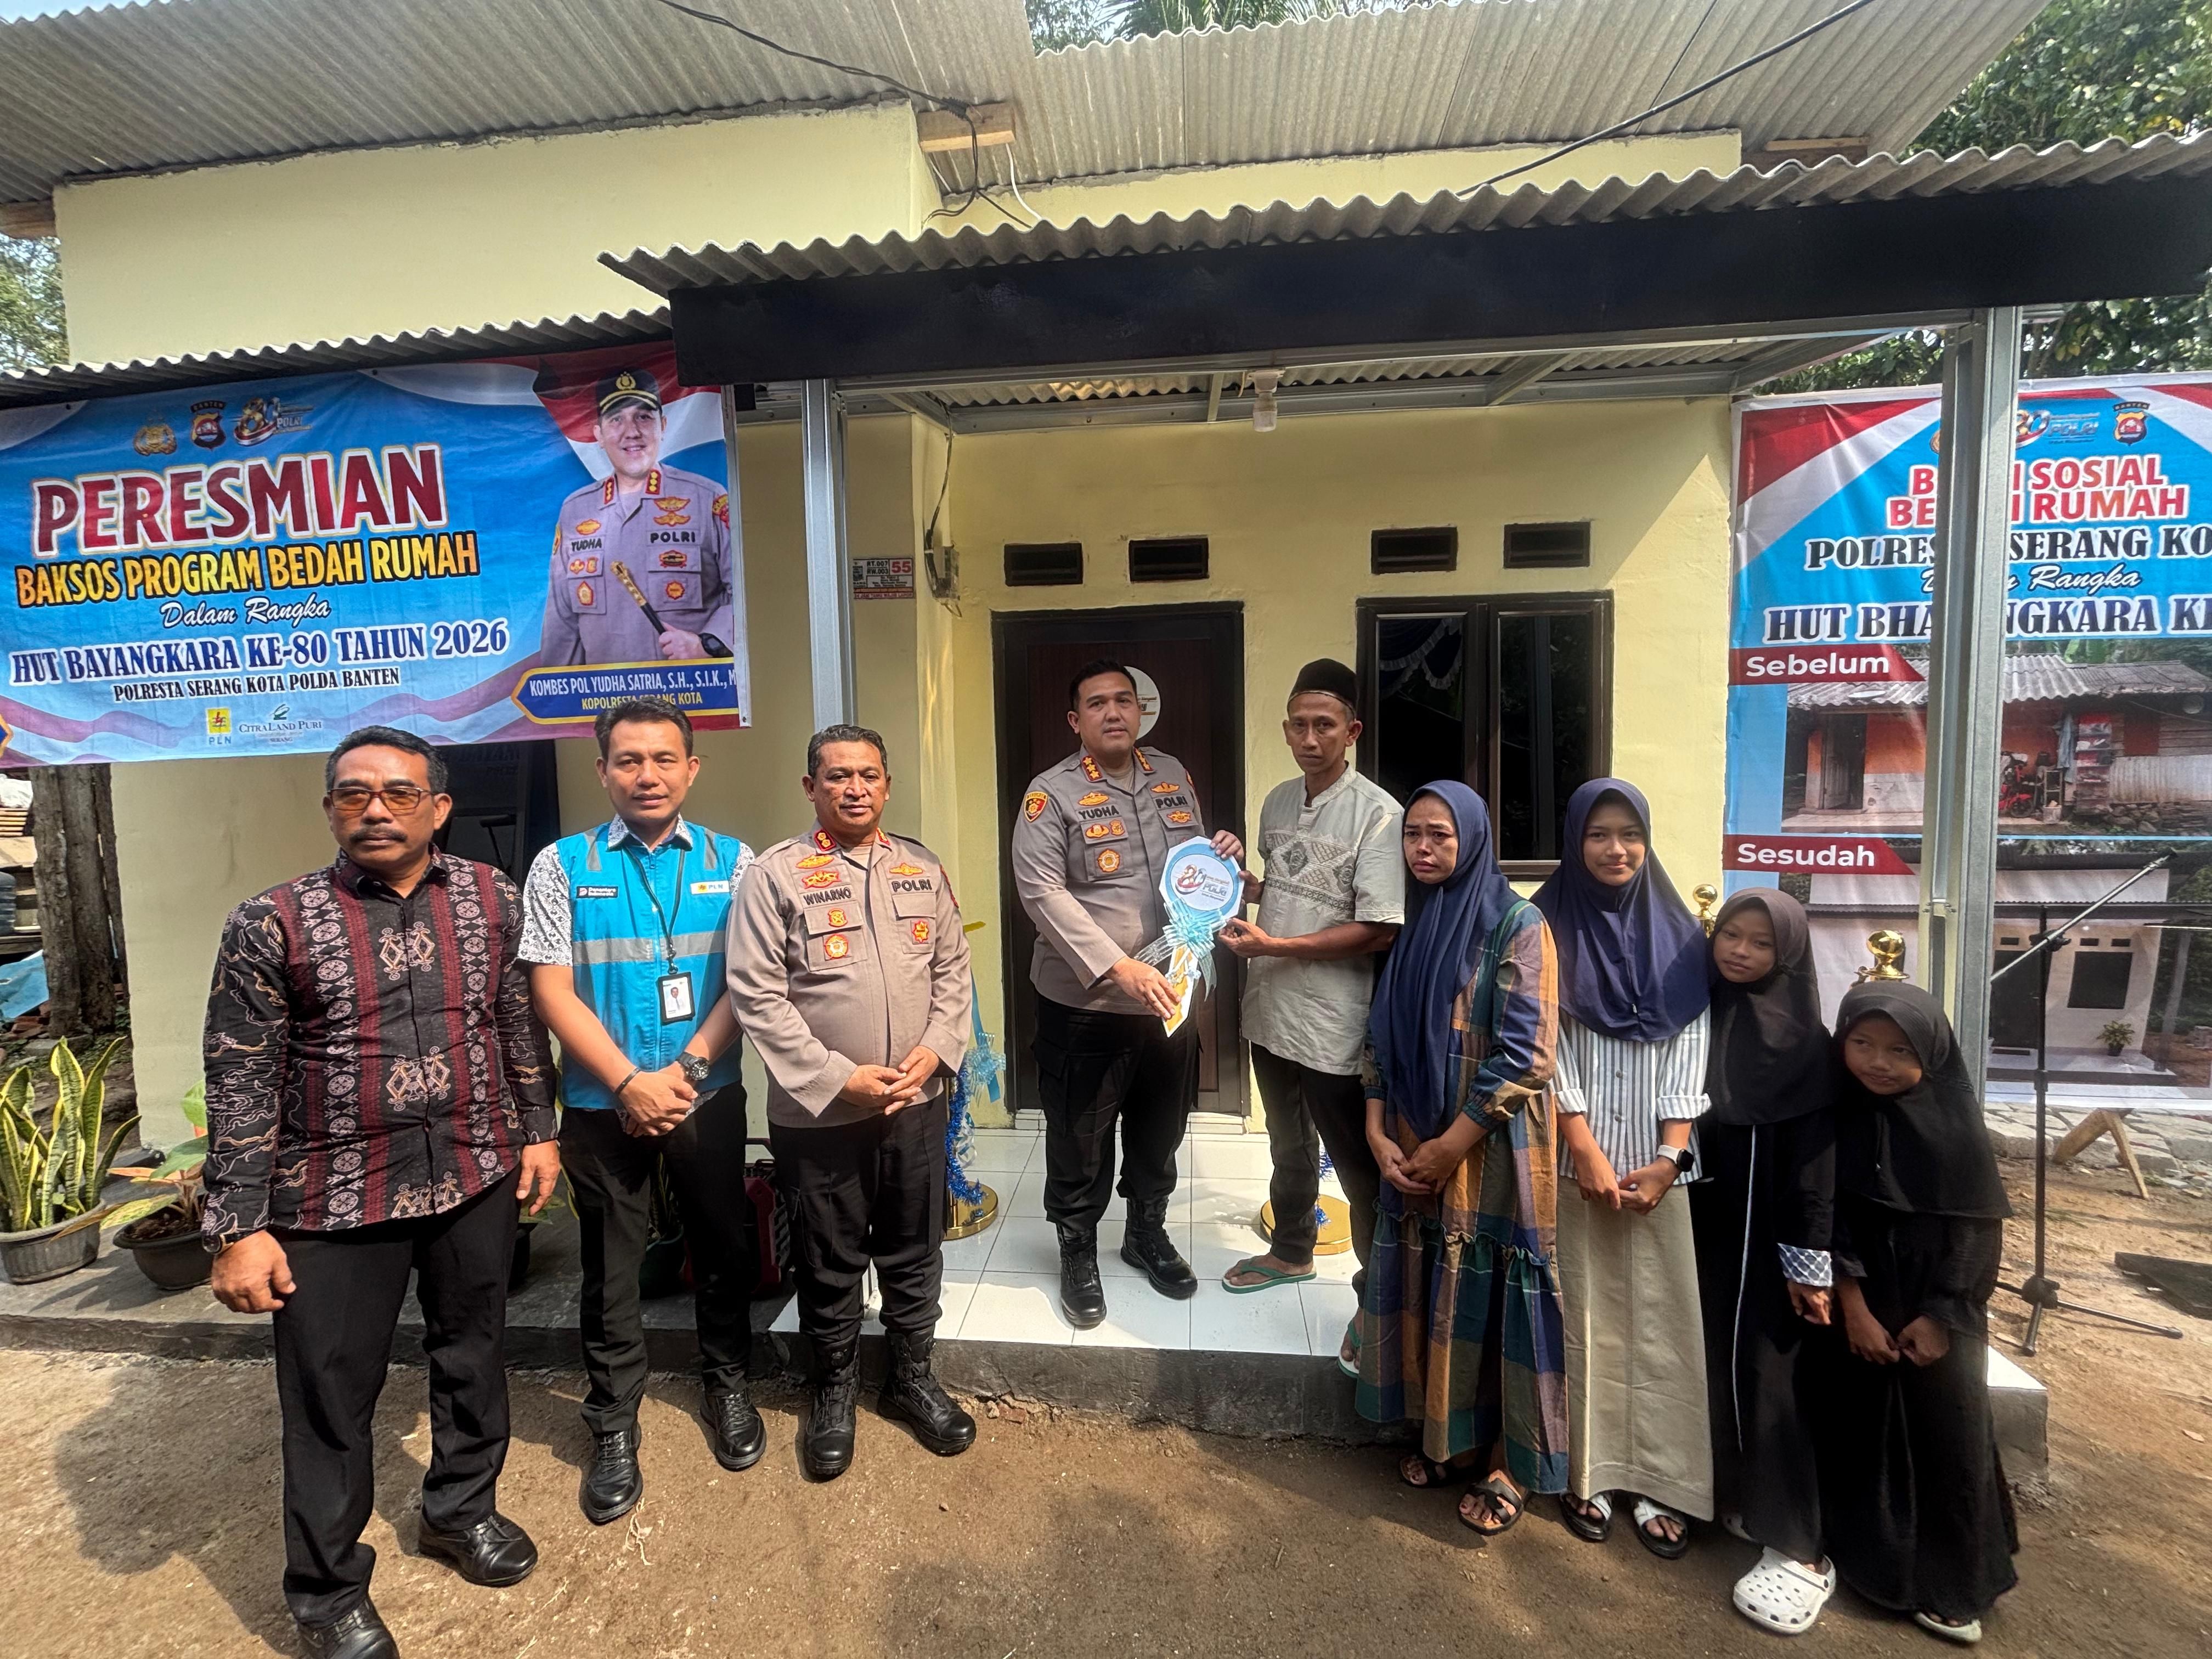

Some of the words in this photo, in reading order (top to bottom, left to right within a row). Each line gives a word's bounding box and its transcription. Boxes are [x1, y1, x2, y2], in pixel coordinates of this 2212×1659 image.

[2032, 457, 2164, 489] SOSIAL
[35, 447, 445, 556] PERESMIAN
[2033, 487, 2185, 522] RUMAH
[571, 538, 602, 552] YUDHA
[650, 531, 696, 543] POLRI
[2010, 528, 2148, 560] SERANG
[17, 558, 121, 606] BAKSOS
[124, 549, 262, 598] PROGRAM
[266, 541, 365, 588] BEDAH
[370, 533, 478, 580] RUMAH
[891, 561, 911, 573] 55
[2030, 564, 2141, 595] Rangka
[161, 601, 236, 627] Dalam
[246, 594, 330, 627] Rangka
[1767, 607, 1847, 641] HUT
[12, 652, 60, 684] HUT
[65, 640, 240, 680] BAYANGKARA
[246, 634, 327, 668] KE-80
[335, 627, 425, 662] TAHUN
[433, 620, 507, 656] 2026
[1746, 652, 1889, 677] Sebelum
[114, 683, 184, 702] POLRESTA
[188, 679, 241, 696] SERANG
[246, 676, 285, 692] KOTA
[289, 672, 338, 690] POLDA
[342, 668, 399, 687] BANTEN
[530, 678, 569, 697] KOMBES
[571, 677, 590, 694] POL
[591, 675, 626, 692] YUDHA
[627, 672, 667, 692] SATRIA,
[668, 671, 693, 691] S.H.,
[695, 669, 727, 689] S.I.K.,
[678, 692, 703, 705] KOTA
[209, 736, 232, 745] PLN
[1078, 805, 1120, 819] YUDHA
[1156, 795, 1189, 809] POLRI
[1737, 843, 1875, 867] Sesudah
[804, 887, 851, 905] WINARNO
[891, 879, 932, 892] POLRI
